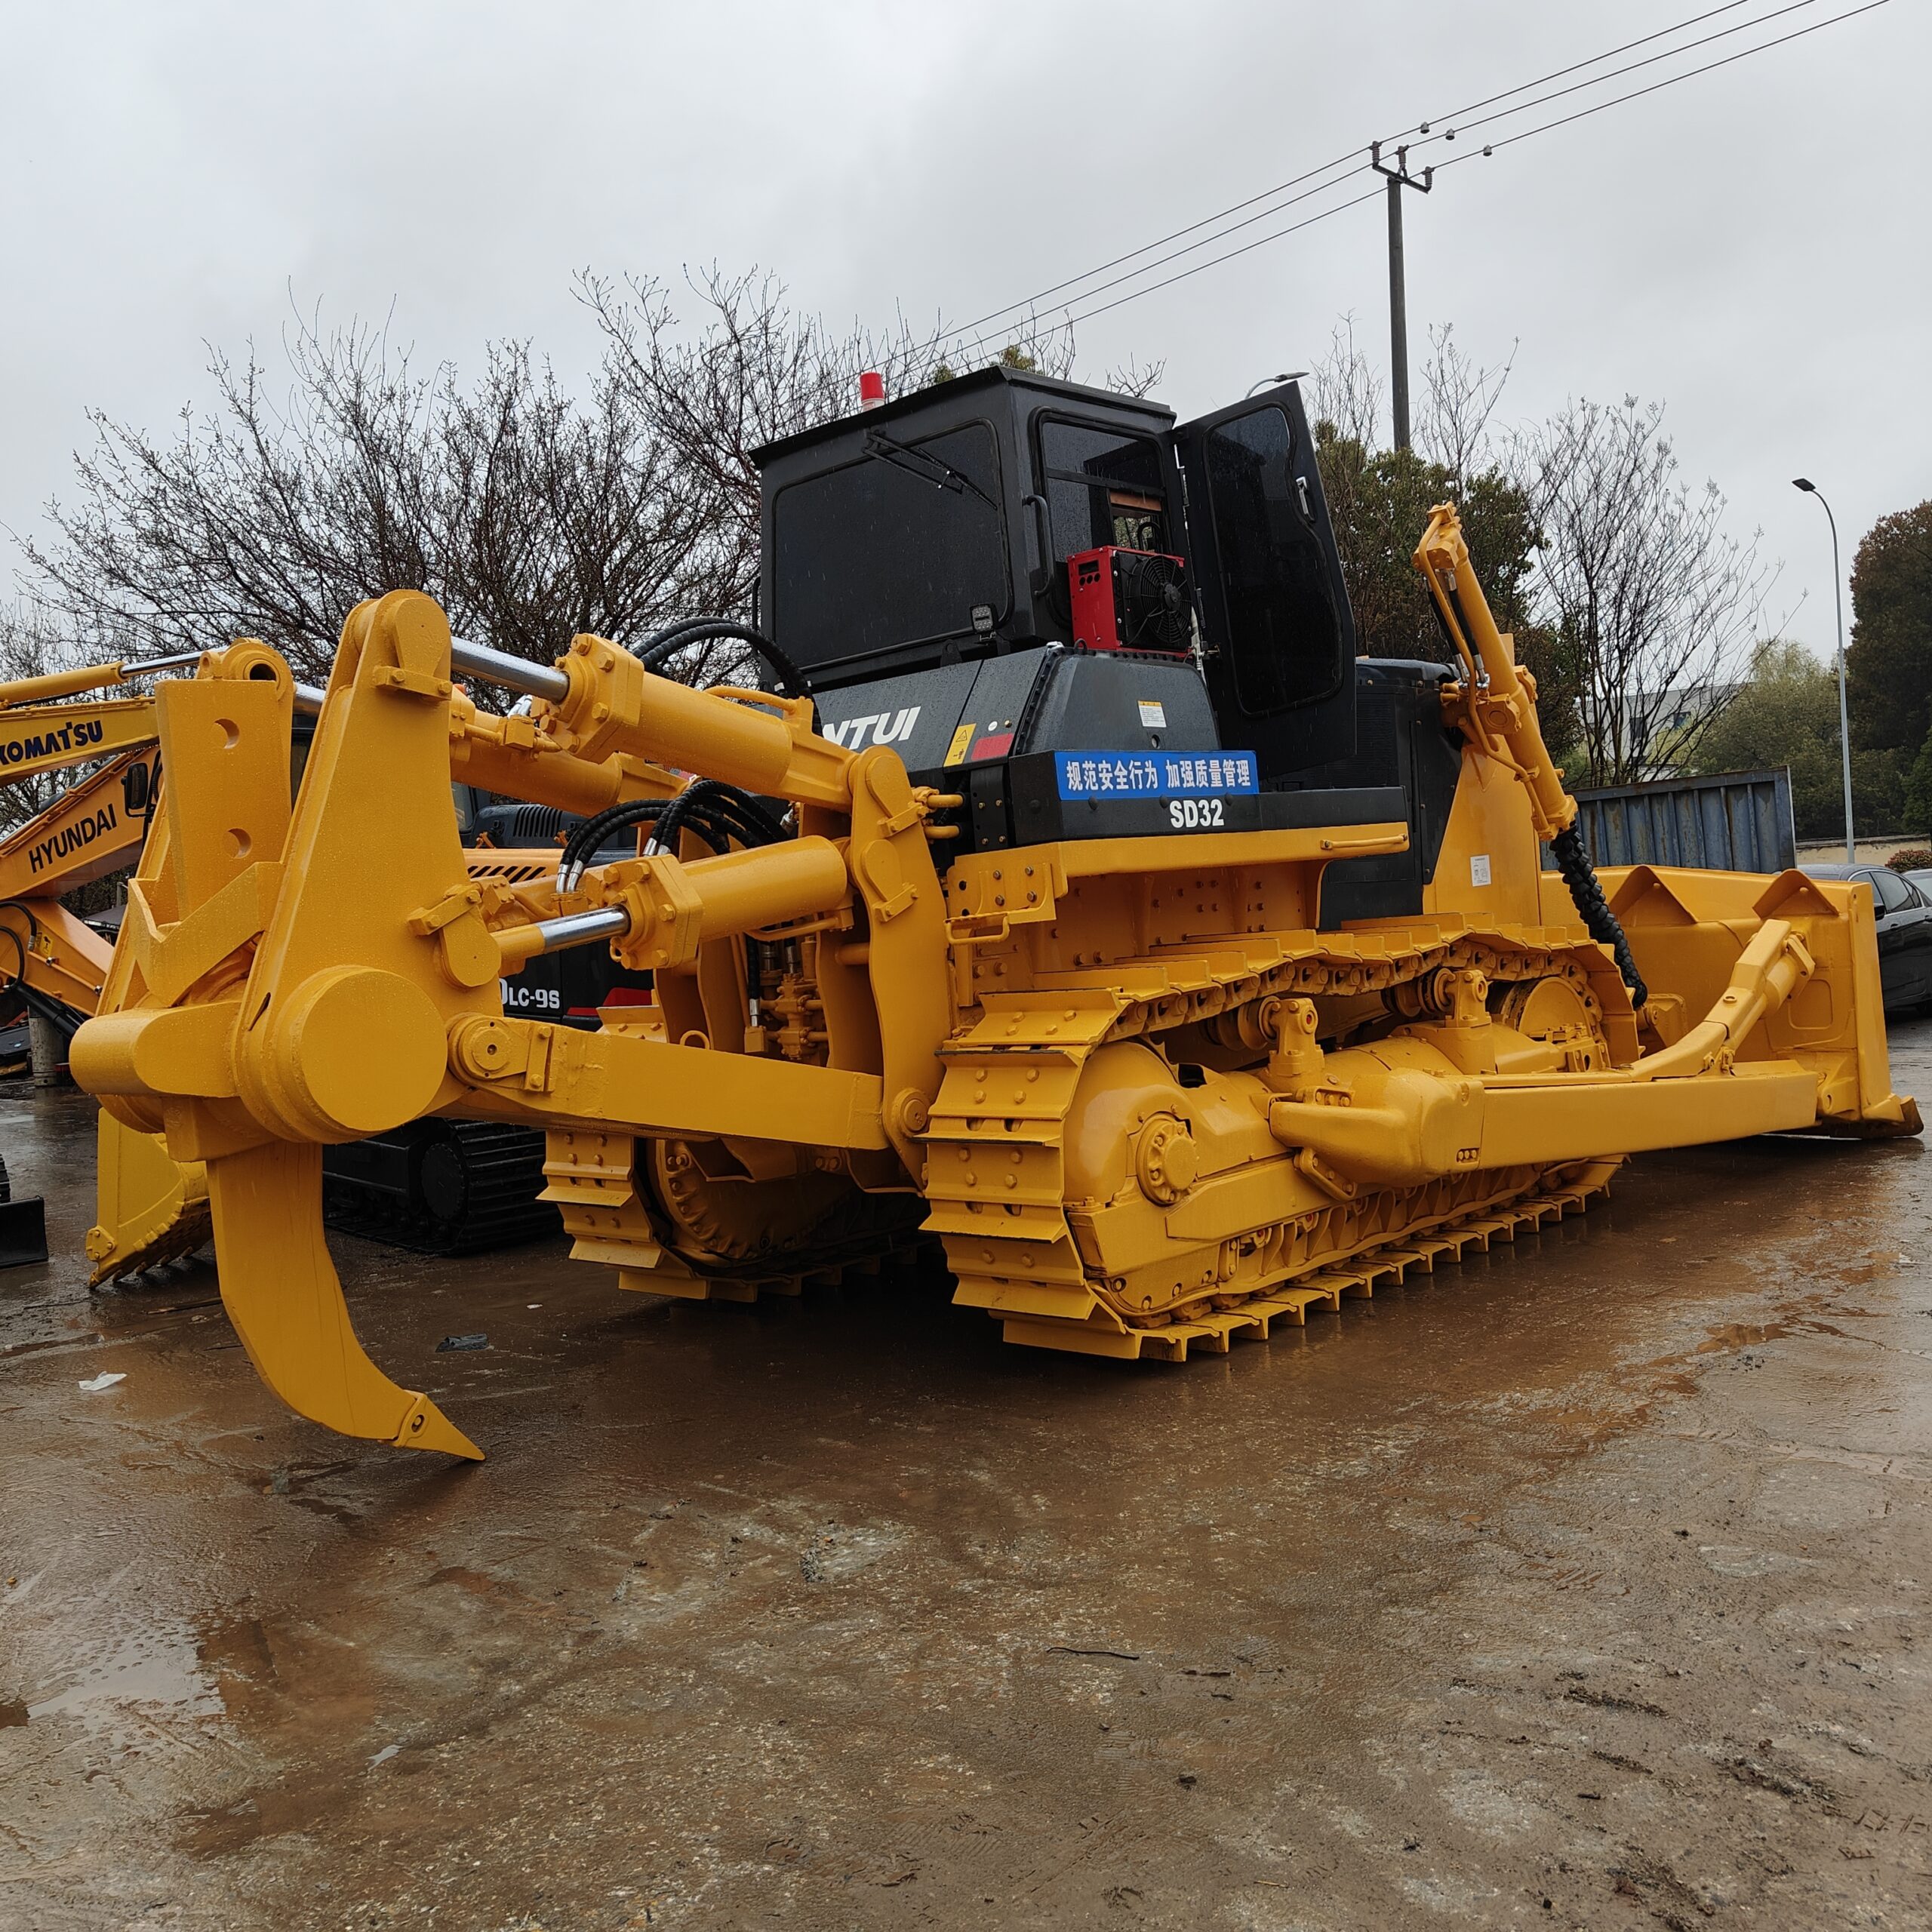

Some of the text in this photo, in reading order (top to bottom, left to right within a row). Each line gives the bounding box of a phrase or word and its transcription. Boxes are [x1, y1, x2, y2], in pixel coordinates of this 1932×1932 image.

[1066, 759, 1251, 791] 规范安全行为 加强质量管理
[1170, 798, 1224, 828] SD32
[29, 804, 117, 873] HYUNDAI
